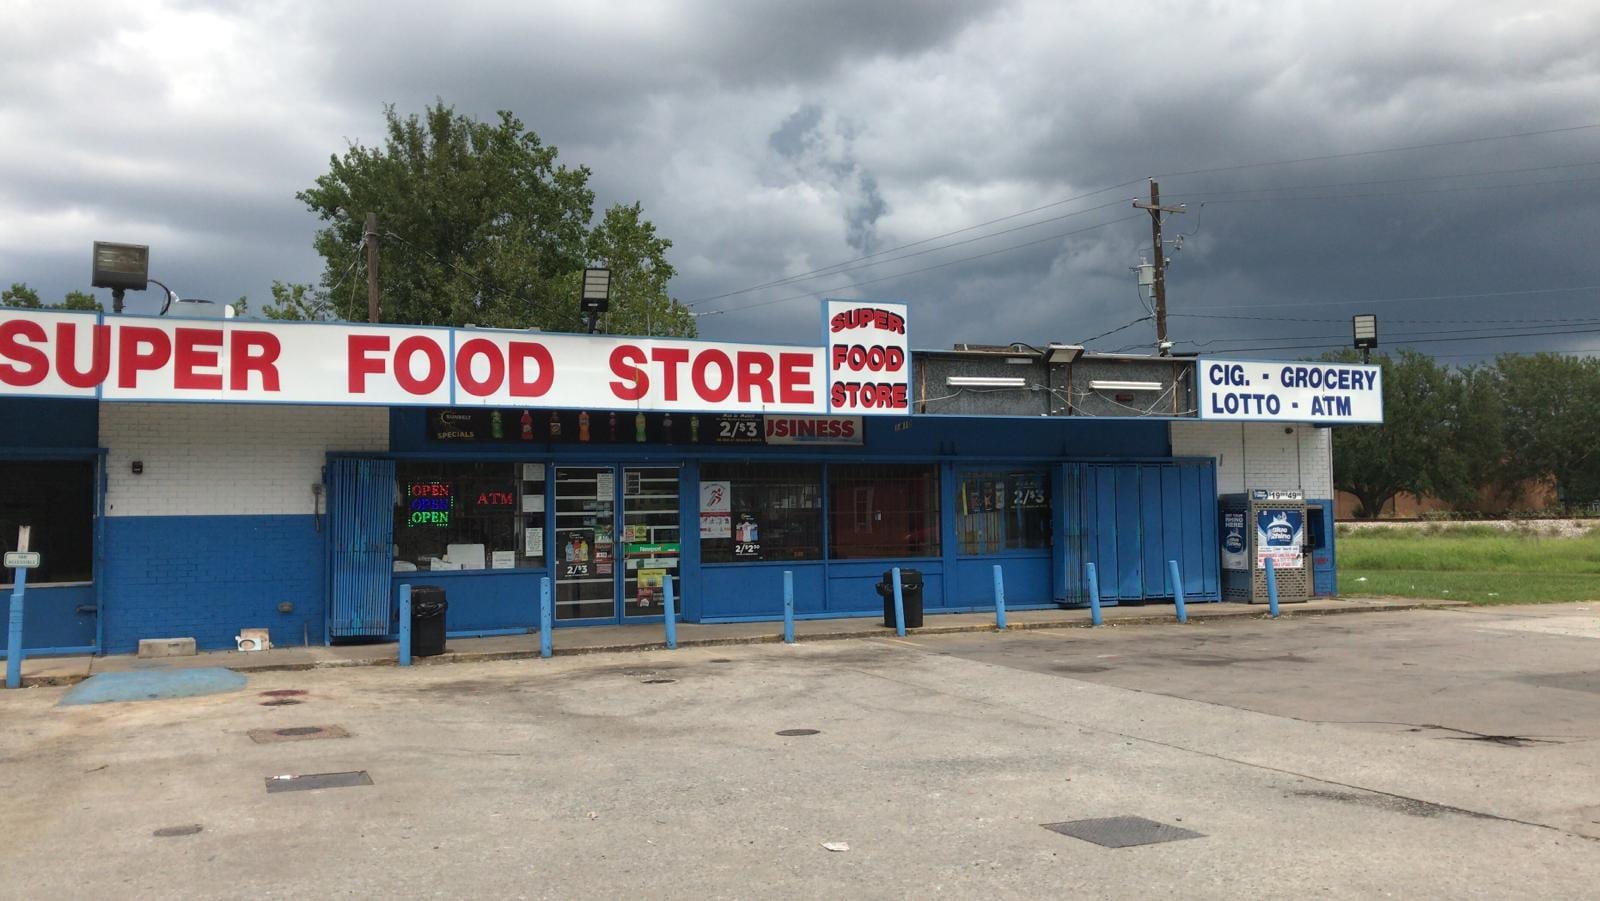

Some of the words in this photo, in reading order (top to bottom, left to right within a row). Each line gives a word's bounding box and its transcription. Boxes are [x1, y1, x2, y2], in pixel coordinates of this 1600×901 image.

[831, 308, 905, 334] SUPER
[0, 319, 281, 392] SUPER
[348, 334, 554, 397] FOOD
[609, 344, 814, 404] STORE
[833, 344, 904, 372] FOOD
[1209, 364, 1250, 386] CIG.
[1280, 366, 1377, 390] GROCERY
[831, 381, 907, 408] STORE
[1212, 393, 1281, 415] LOTTO
[1311, 395, 1352, 416] ATM
[437, 431, 474, 440] SPECIALS
[719, 420, 758, 438] 2/$3
[411, 484, 449, 496] OPEN
[477, 491, 513, 505] ATM
[411, 498, 449, 510] OPEN
[411, 511, 449, 523] OPEN
[566, 565, 589, 575] 2/$3
